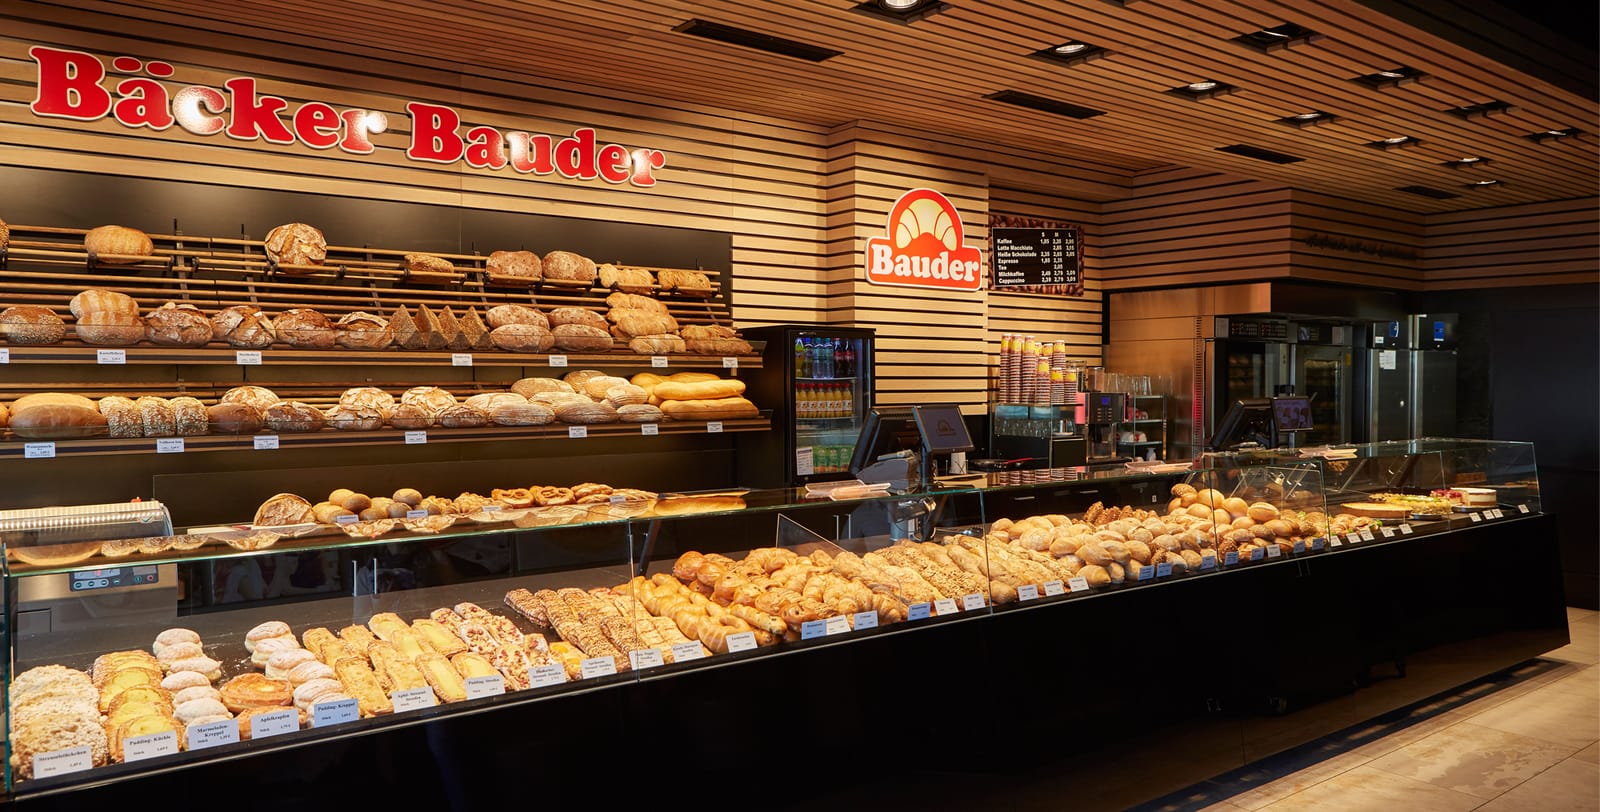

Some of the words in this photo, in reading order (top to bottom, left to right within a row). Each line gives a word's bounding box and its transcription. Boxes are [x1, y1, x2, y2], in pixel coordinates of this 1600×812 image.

[30, 47, 388, 154] Bäcker
[406, 101, 665, 187] Bauder
[871, 244, 979, 282] Bauder
